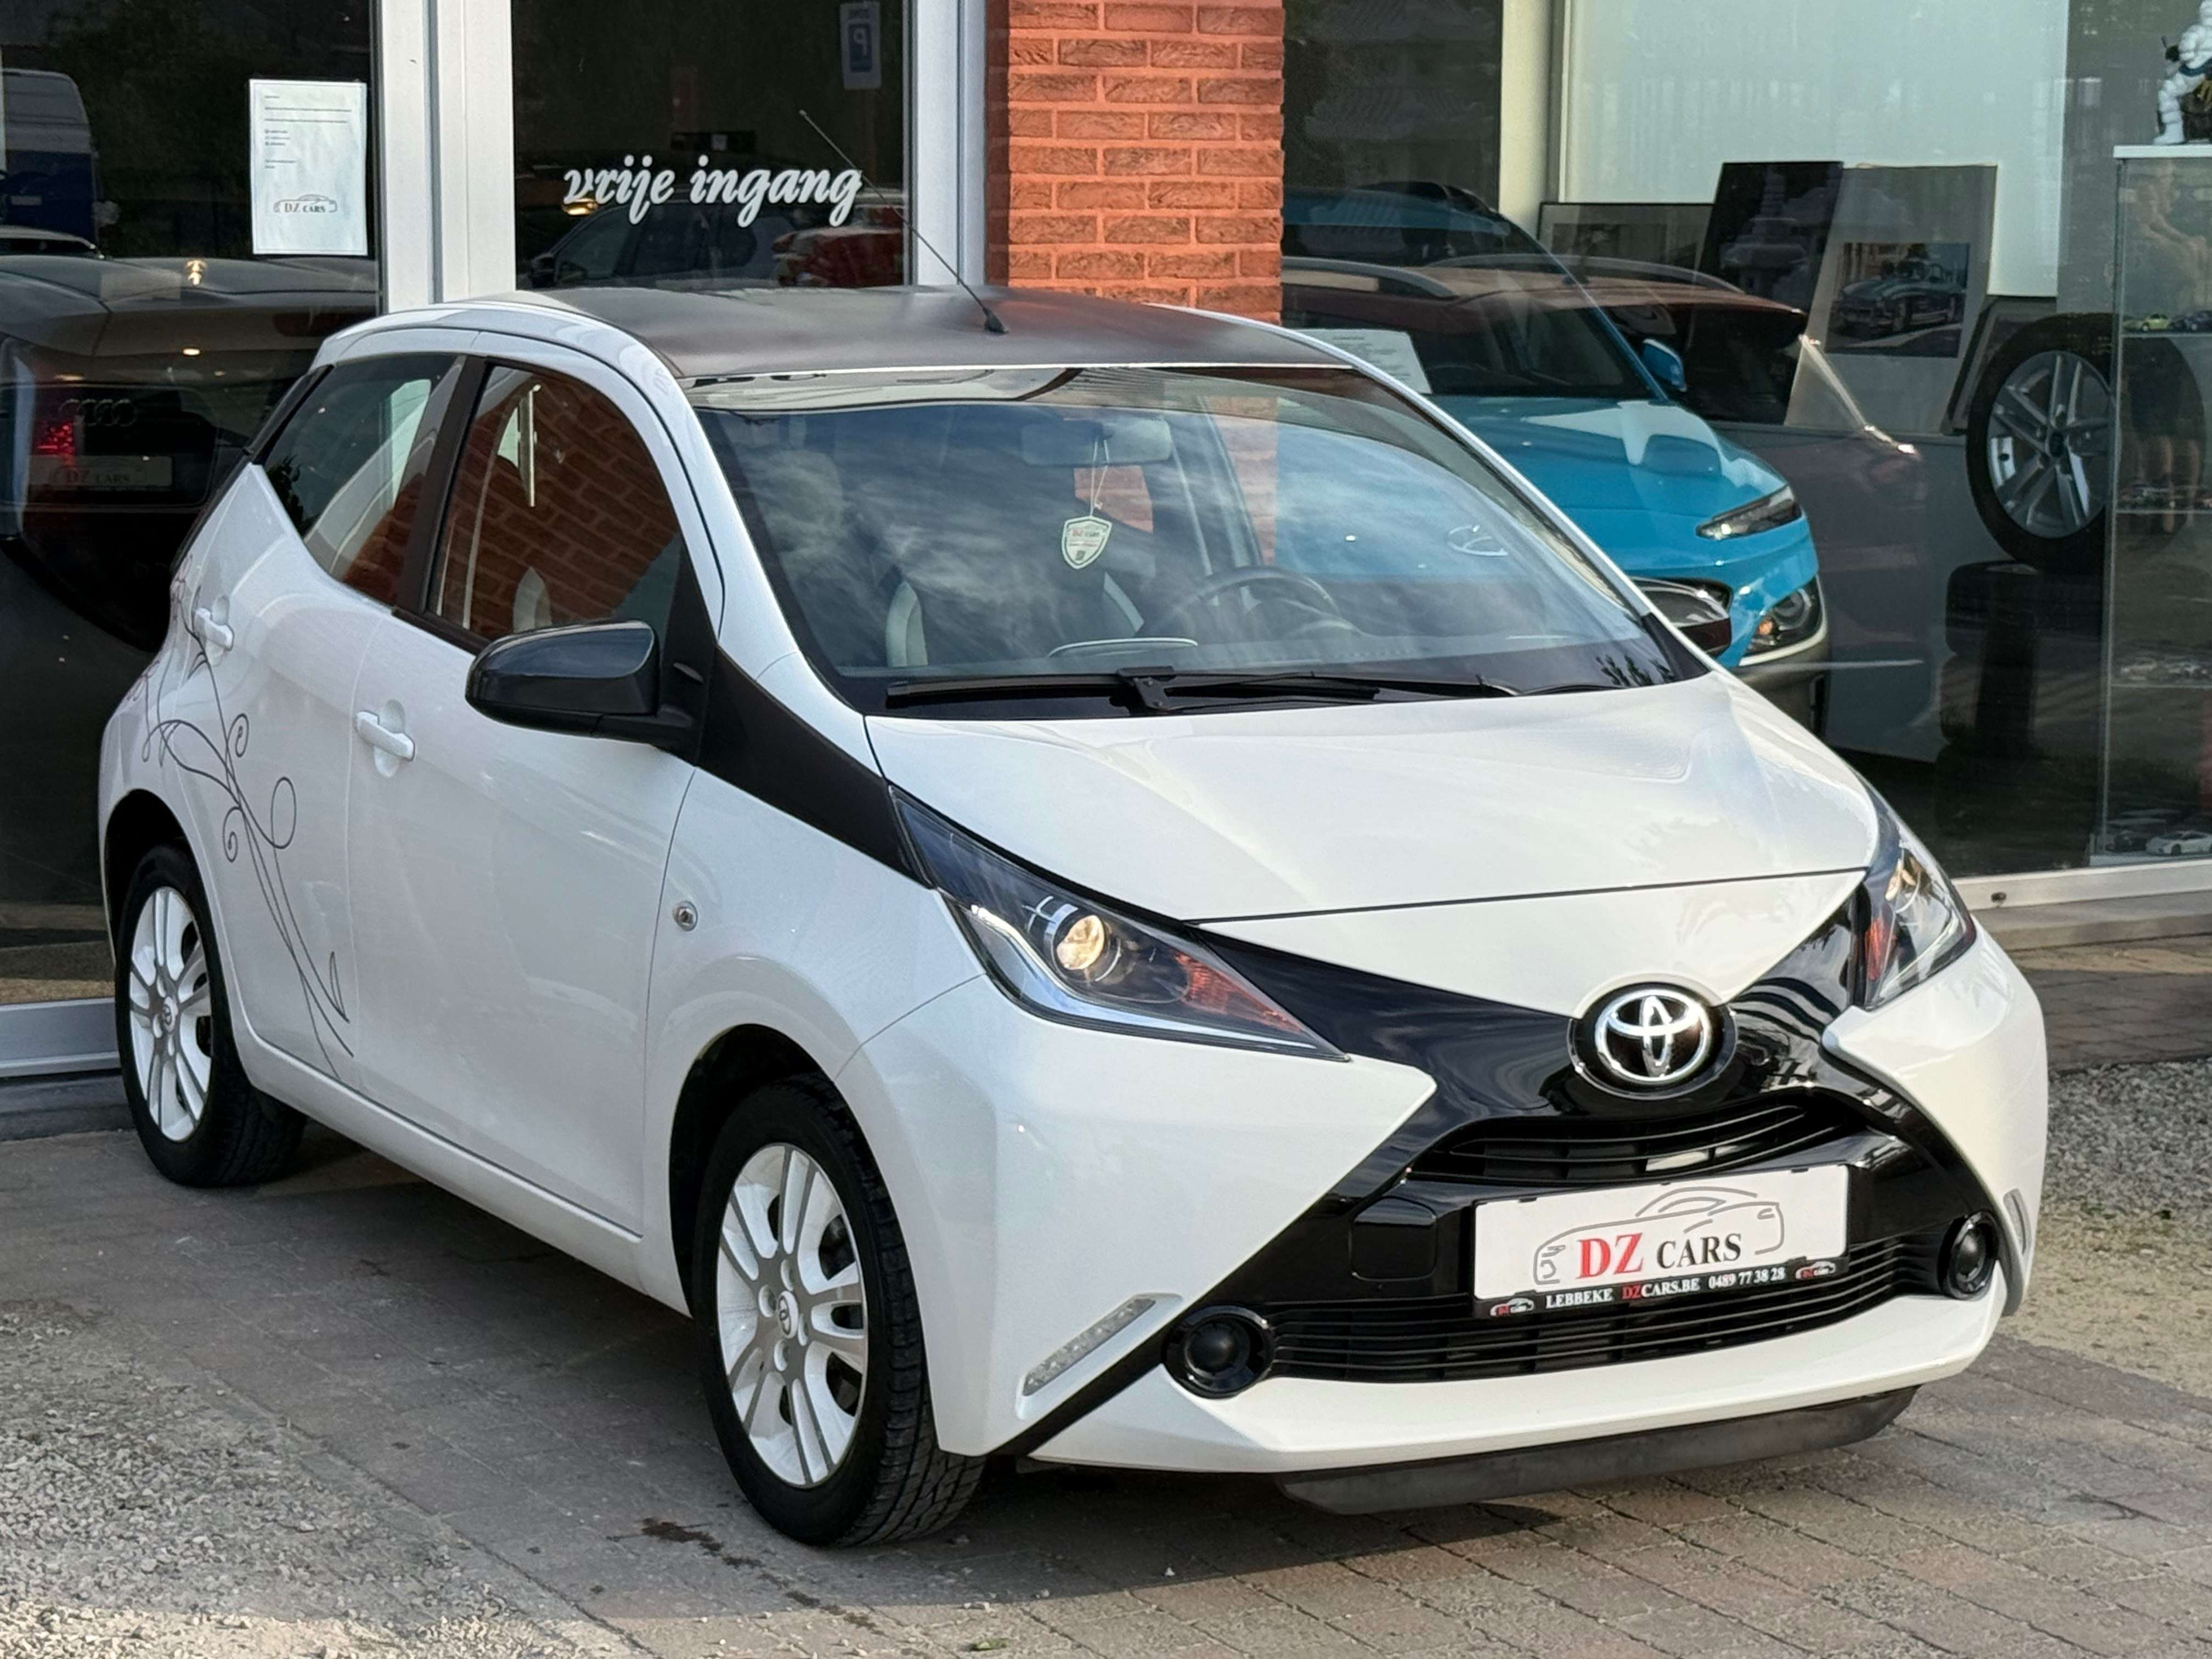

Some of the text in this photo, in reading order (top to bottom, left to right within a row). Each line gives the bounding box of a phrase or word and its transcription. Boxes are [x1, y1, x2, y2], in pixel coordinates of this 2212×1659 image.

[284, 202, 325, 213] DZ CARS
[565, 154, 862, 228] vrije ingang
[1576, 1232, 1741, 1279] DZ CARS
[1545, 1288, 1613, 1309] LEBBEKE
[1622, 1278, 1701, 1299] DZCARS.BE
[1708, 1273, 1736, 1289] 0489
[1738, 1271, 1752, 1285] 77
[1754, 1269, 1769, 1284] 38
[1770, 1267, 1786, 1282] 28
